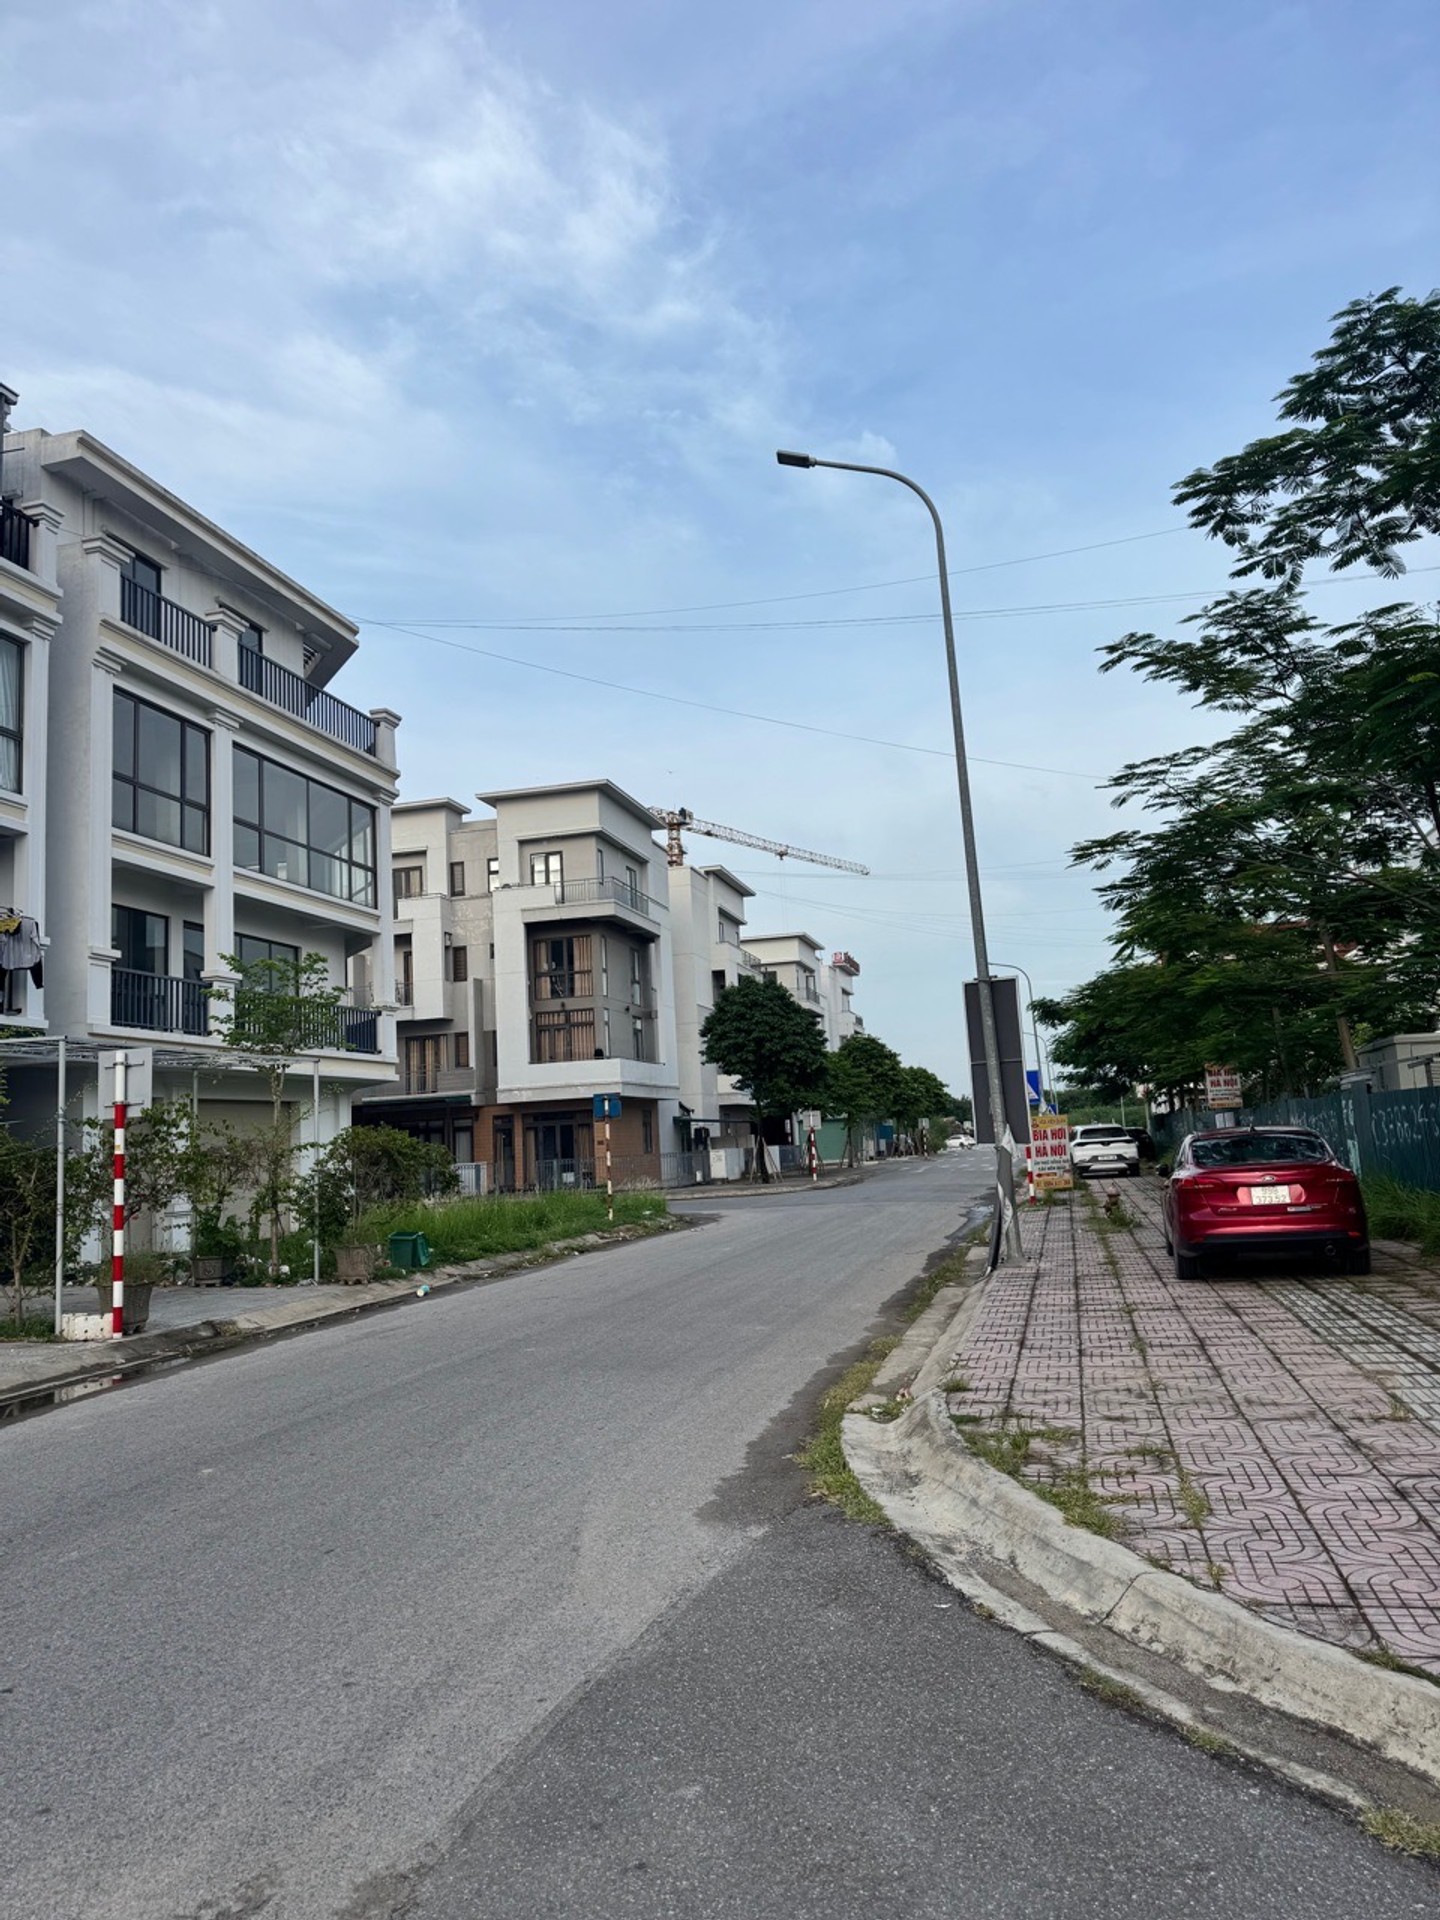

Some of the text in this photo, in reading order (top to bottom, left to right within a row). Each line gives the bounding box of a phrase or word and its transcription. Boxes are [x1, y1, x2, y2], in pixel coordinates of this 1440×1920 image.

[1032, 1129, 1049, 1141] BIA
[1035, 1142, 1067, 1159] HÀ NỘI
